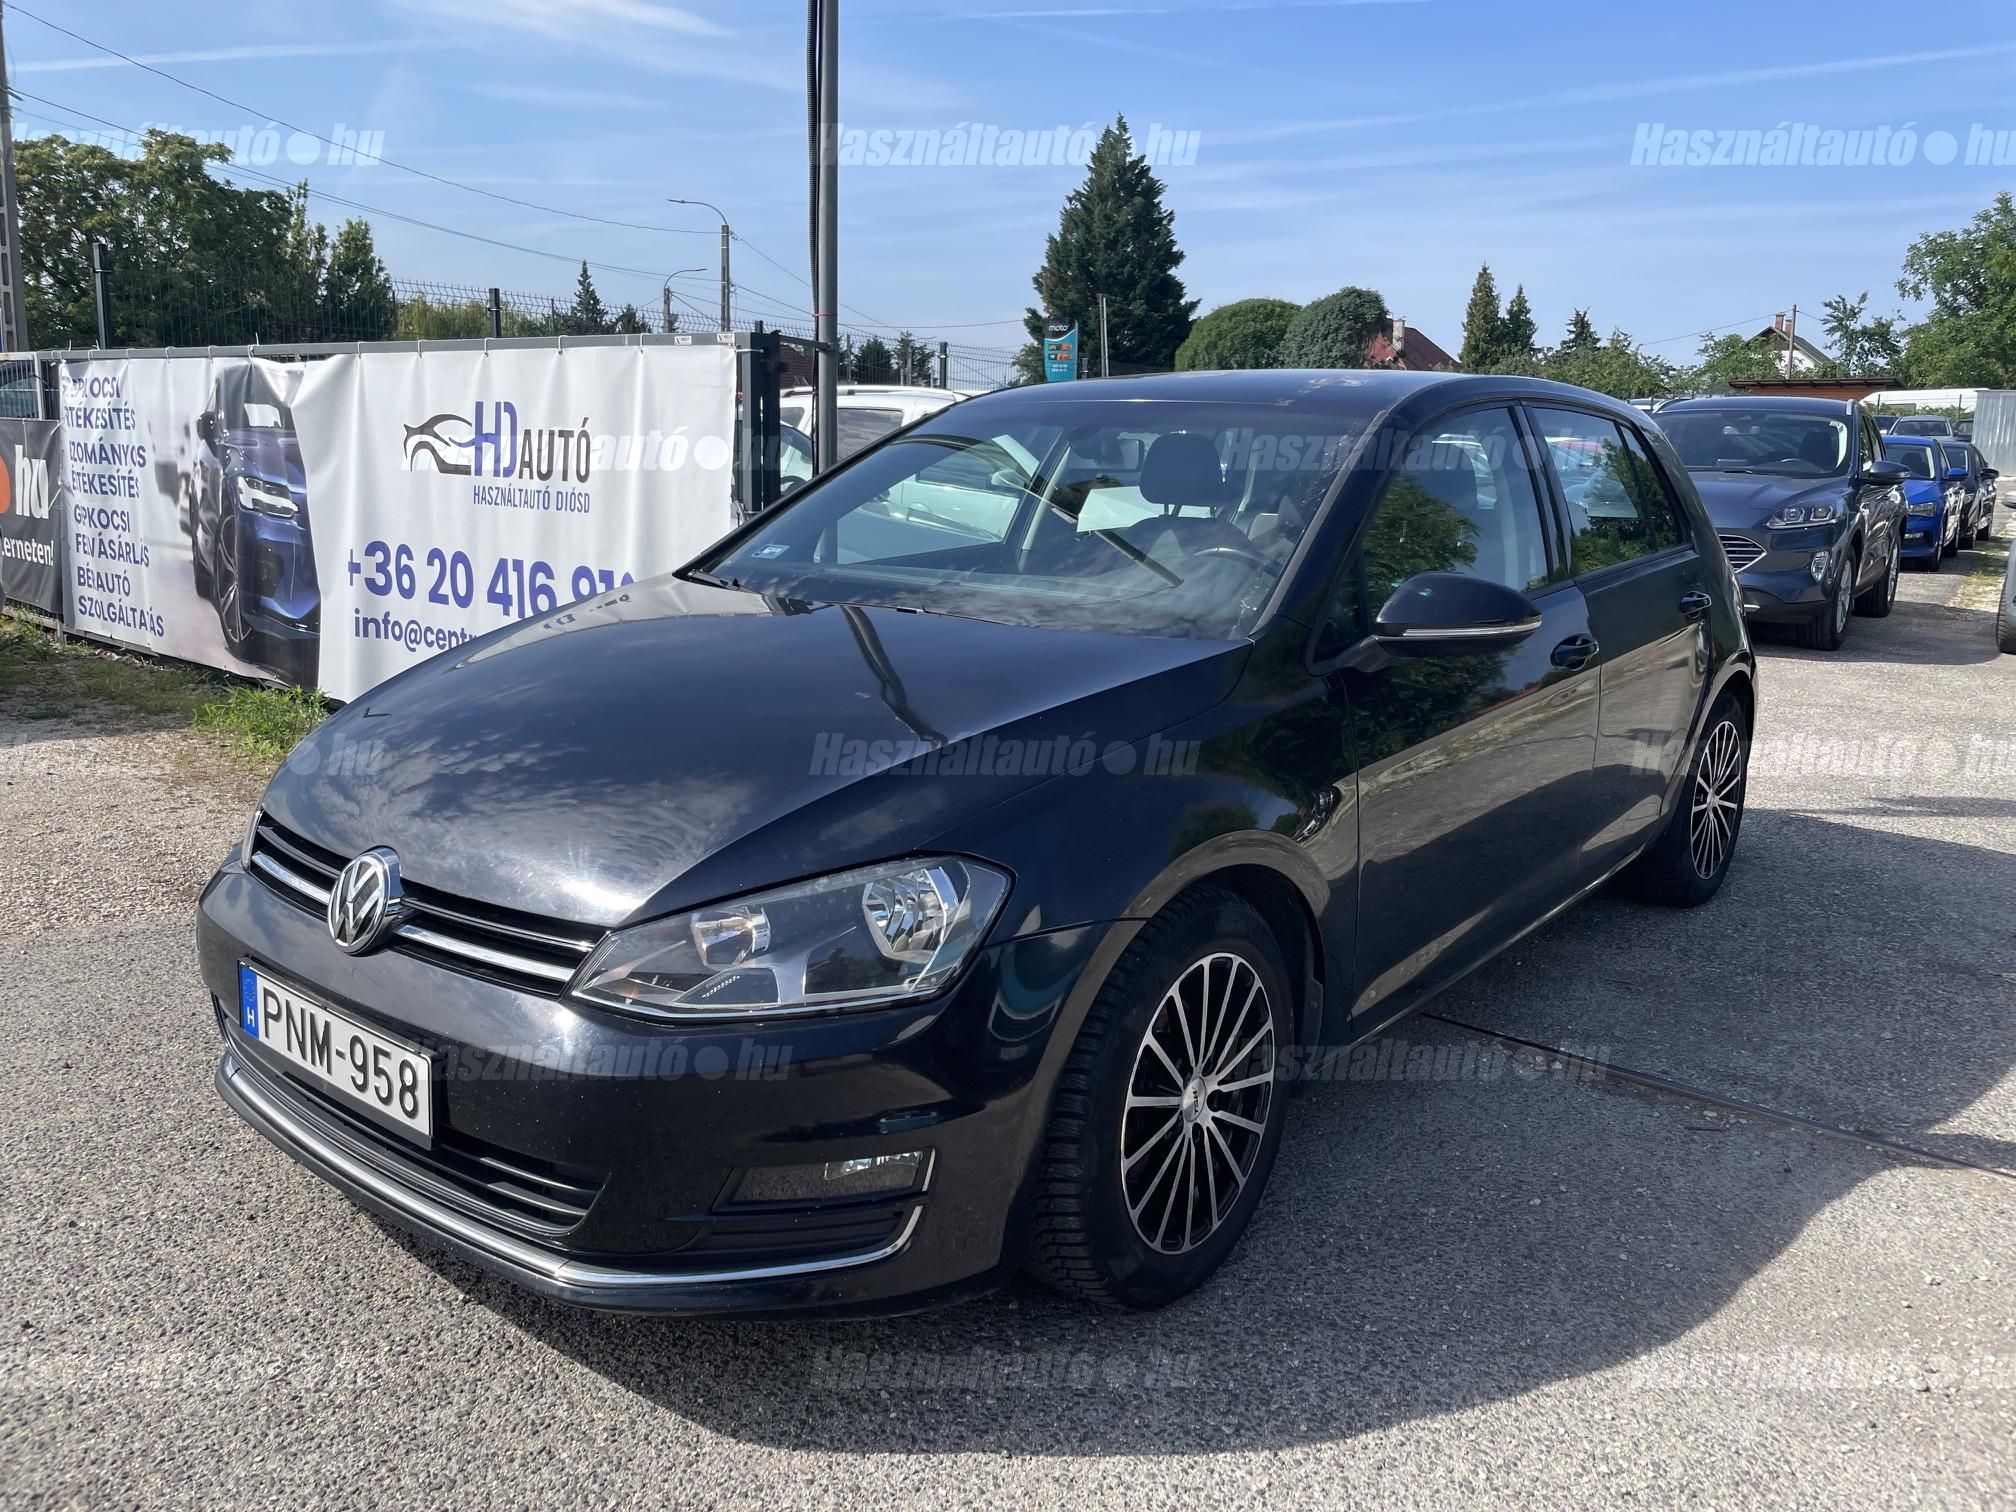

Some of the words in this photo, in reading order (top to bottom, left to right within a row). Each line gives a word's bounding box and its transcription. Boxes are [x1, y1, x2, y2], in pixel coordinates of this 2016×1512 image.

[473, 482, 551, 511] HASZNÁLTAUTÓ
[555, 490, 591, 514] DIÓSD
[348, 540, 417, 600] +36
[426, 547, 475, 609] 20
[486, 557, 558, 619] 416
[246, 1005, 255, 1028] H
[262, 985, 420, 1121] PNM-958
